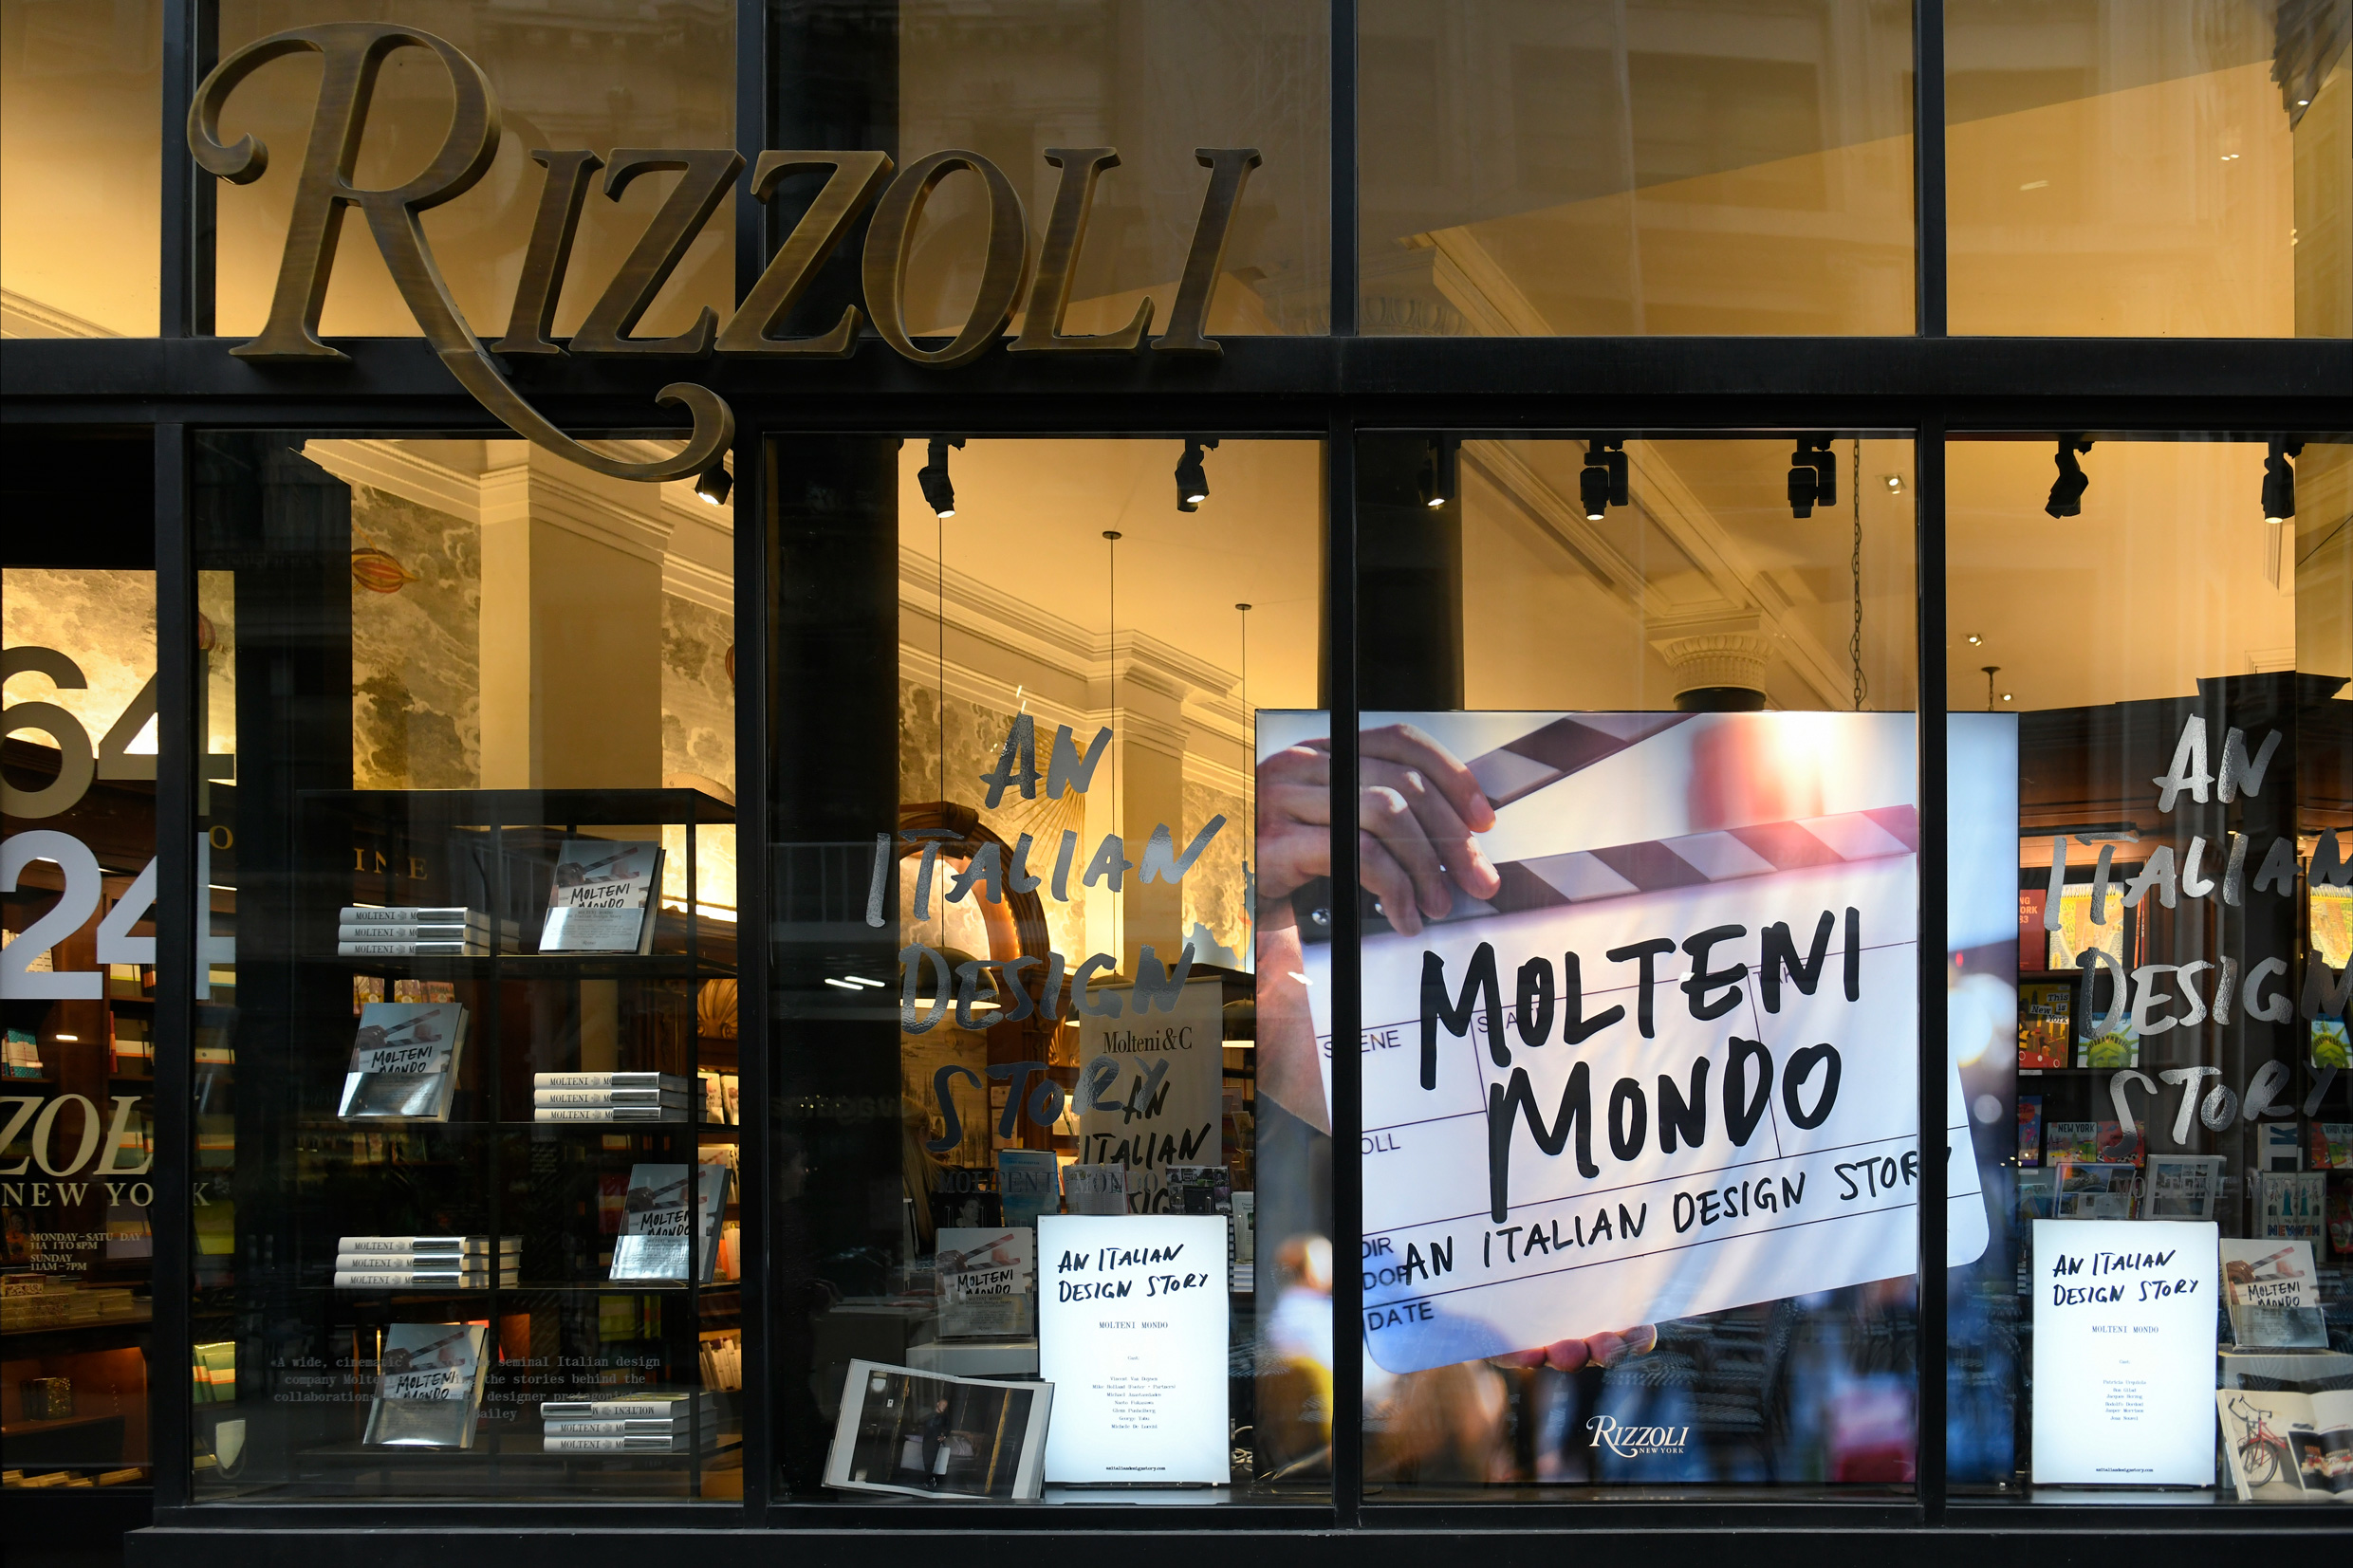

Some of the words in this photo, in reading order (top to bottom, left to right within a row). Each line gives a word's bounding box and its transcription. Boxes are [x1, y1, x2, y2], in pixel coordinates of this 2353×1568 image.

[189, 21, 1262, 482] RIZZOLI
[0, 646, 234, 819] 64
[979, 710, 1113, 809] AN
[2153, 712, 2283, 813] AN
[354, 848, 427, 880] INE
[865, 814, 1227, 928] ITALIAN
[2044, 825, 2353, 932] ITALIAN
[570, 883, 630, 905] MOLTENI
[0, 829, 236, 999] 24
[356, 912, 395, 920] MOLTENI
[355, 929, 394, 937] MOLTENI
[354, 945, 394, 953] MOLTENI
[899, 941, 1195, 1035] DESIGN
[1420, 906, 1860, 1090] MOLTENI
[2075, 946, 2353, 1041] DESIGN
[2030, 1005, 2051, 1014] New
[2048, 1015, 2067, 1024] York
[1102, 1026, 1193, 1054] Molteni&C
[1324, 1029, 1401, 1058] SENE
[371, 1046, 433, 1068] MOLTENI
[926, 1055, 1170, 1153] STORY
[1121, 1074, 1171, 1124] AN
[2103, 1060, 2338, 1158] STORY
[1488, 1036, 1843, 1224] MONDO
[2058, 1123, 2074, 1133] NEW
[2076, 1123, 2095, 1133] YORK
[1083, 1123, 1211, 1171] ITALIAN
[1362, 1133, 1401, 1154] OLL
[2, 1182, 89, 1207] NEW
[104, 1182, 211, 1207] YOK
[1075, 1171, 1158, 1194] MONDO
[2114, 1176, 2229, 1199] MOTENI
[640, 1210, 689, 1230] MOLTEN
[1403, 1236, 1453, 1285] AN
[1484, 1201, 1647, 1269] ITALIAN
[1673, 1171, 1806, 1233] DESIGN
[1834, 1147, 1952, 1201] STOR
[30, 1232, 141, 1241] MONDAY-SATUDAY
[59, 1242, 74, 1250] TO
[76, 1242, 98, 1250] 8PM
[355, 1242, 393, 1250] MOLTENI
[352, 1259, 390, 1267] MOLTENI
[1057, 1249, 1090, 1274] AN
[1099, 1244, 1184, 1272] ITALIAN
[2052, 1254, 2084, 1278] AN
[2092, 1249, 2176, 1277] ITALIAN
[957, 1269, 1013, 1291] MOLTENI
[1059, 1280, 1132, 1302] DESIGN
[1146, 1272, 1209, 1298] STORY
[2053, 1283, 2124, 1306] DESIGN
[2138, 1279, 2199, 1301] STORY
[2248, 1282, 2301, 1301] MOLTENI
[1367, 1301, 1435, 1332] DATE
[2091, 1325, 2127, 1334] MOLTENI
[2133, 1325, 2159, 1334] MONDO
[292, 1356, 326, 1369] wide,
[336, 1356, 401, 1367] cinematic
[499, 1356, 548, 1367] seminal
[557, 1356, 609, 1367] Italian
[616, 1356, 660, 1369] design
[285, 1376, 337, 1388] company
[343, 1374, 397, 1385] Molte
[485, 1374, 505, 1384] the
[512, 1374, 565, 1384] stories
[572, 1374, 616, 1384] behind
[623, 1374, 645, 1384] the
[397, 1371, 455, 1393] MOLTENI
[274, 1392, 375, 1402] collaborations
[487, 1392, 547, 1404] designer
[561, 1440, 600, 1448] MOLTENI
[1585, 1415, 1689, 1458] RIZZOLI
